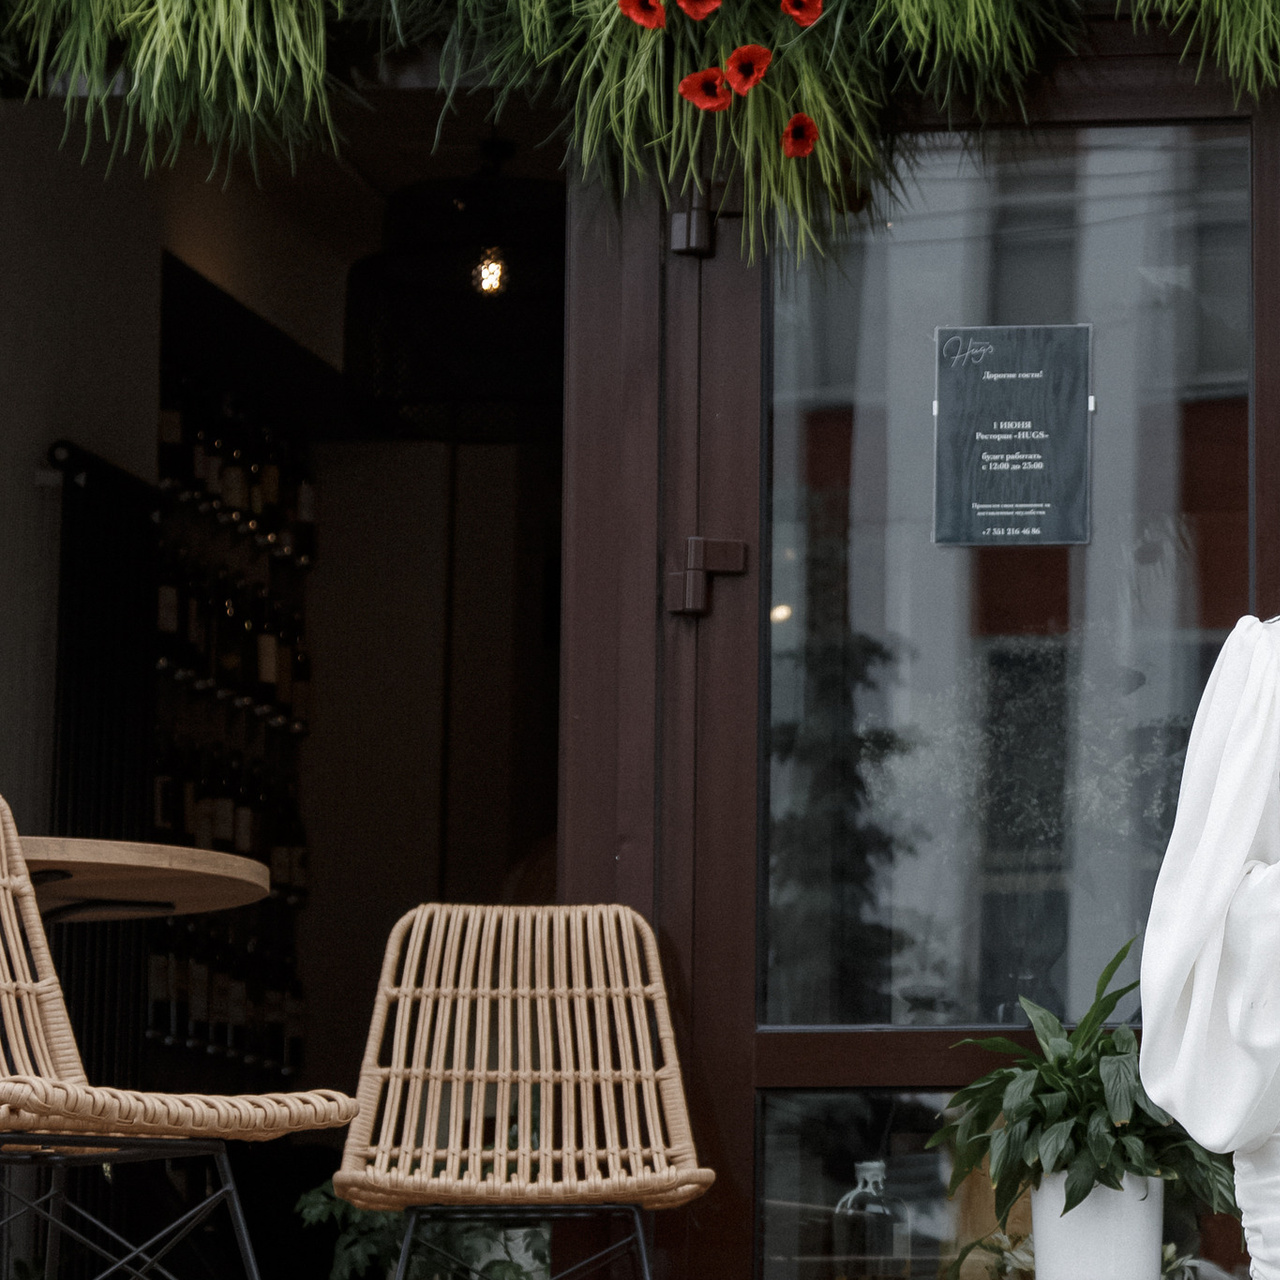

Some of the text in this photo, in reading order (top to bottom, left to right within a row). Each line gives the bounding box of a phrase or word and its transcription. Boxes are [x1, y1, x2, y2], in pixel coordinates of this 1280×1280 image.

[942, 335, 994, 368] Hugs
[999, 420, 1032, 430] ИЮНЯ
[975, 431, 1013, 441] Ресторан
[989, 461, 1010, 470] 12:00
[1006, 527, 1020, 536] 216
